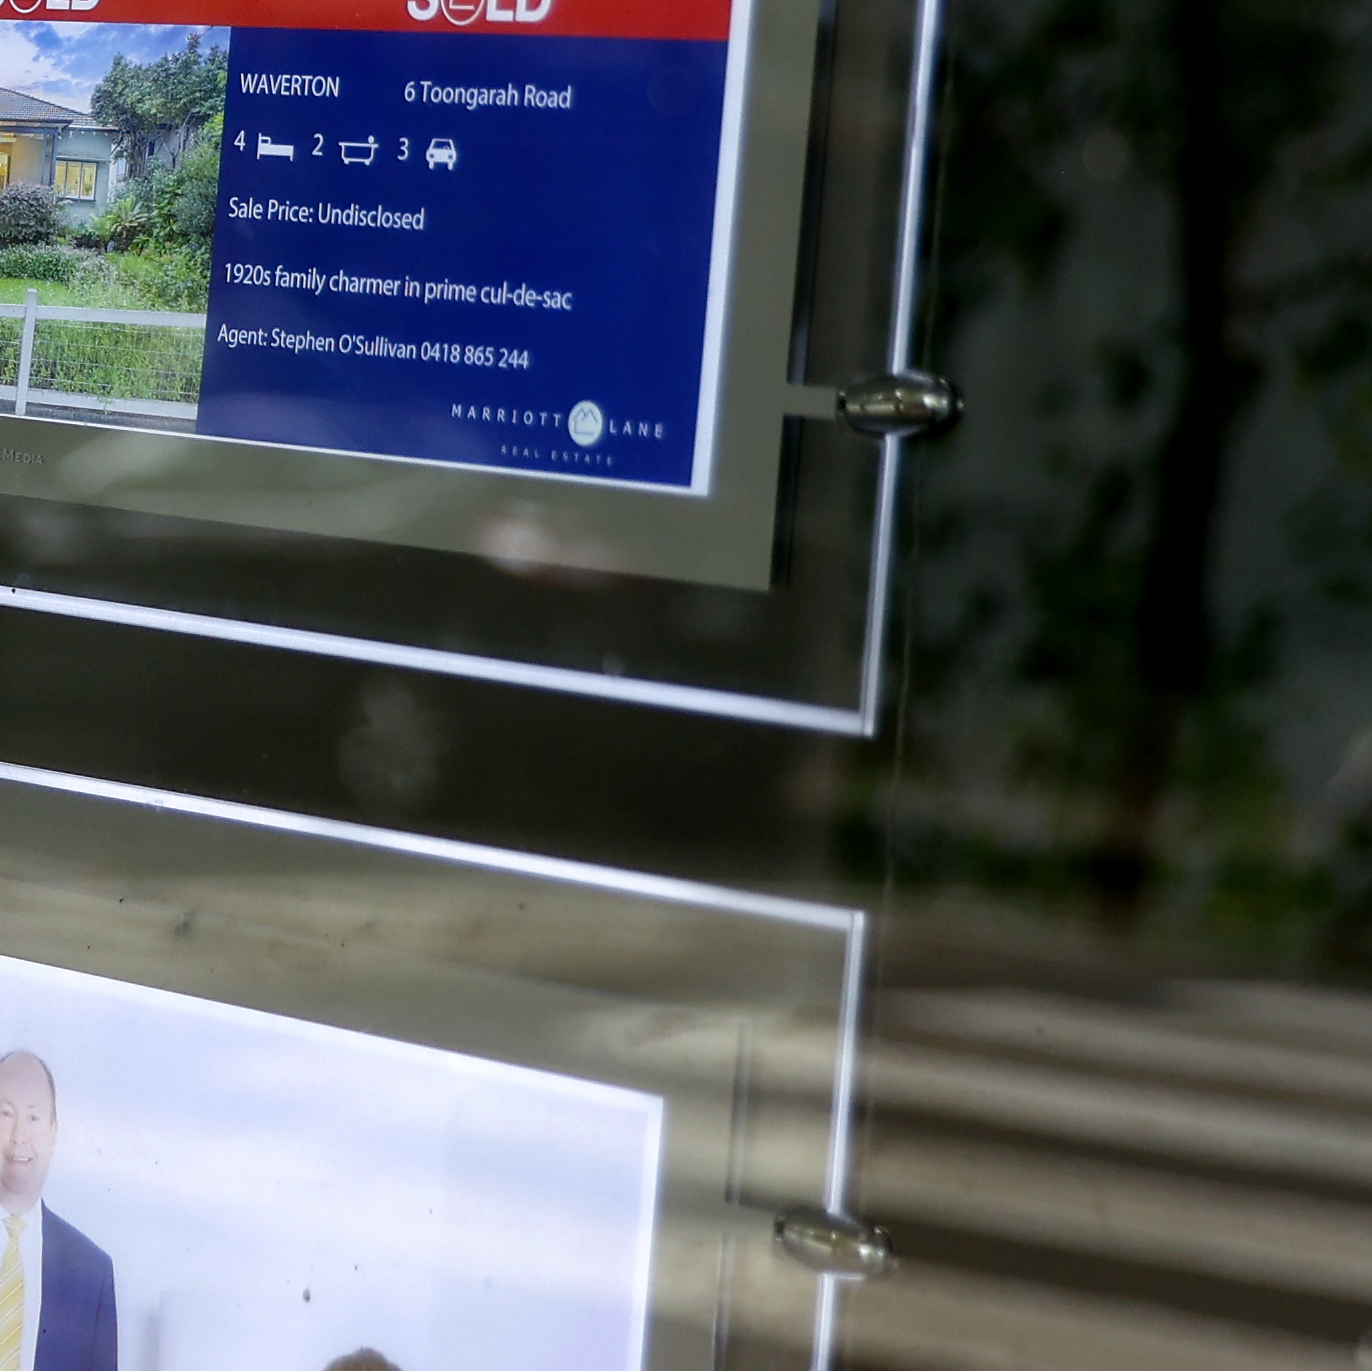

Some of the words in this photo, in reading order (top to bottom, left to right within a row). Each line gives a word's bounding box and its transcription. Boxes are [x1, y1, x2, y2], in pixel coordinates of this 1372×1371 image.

[240, 73, 340, 98] WAVERTON
[404, 81, 416, 103] 6
[420, 81, 518, 110] Toongarah
[523, 84, 573, 109] Road
[233, 130, 246, 151] 4
[311, 133, 324, 156] 2
[397, 137, 409, 161] 3
[228, 196, 263, 220] Sale
[267, 199, 314, 223] Price:
[318, 202, 425, 230] Undisclosed
[224, 263, 271, 285] 1920s
[274, 265, 326, 296] family
[329, 270, 401, 297] charmer
[404, 276, 421, 298] in
[424, 278, 477, 304] prime
[480, 282, 573, 311] cul-de-sac
[217, 323, 268, 348] Agent:
[270, 328, 334, 354] Stephen
[339, 334, 416, 359] O'Sullivan
[421, 341, 460, 363] 0418
[464, 345, 494, 366] 865
[498, 348, 529, 369] 244
[451, 404, 562, 428] MARRIOTT
[609, 419, 664, 439] LANE
[501, 445, 540, 460] REAL
[550, 450, 614, 467] ESTATE
